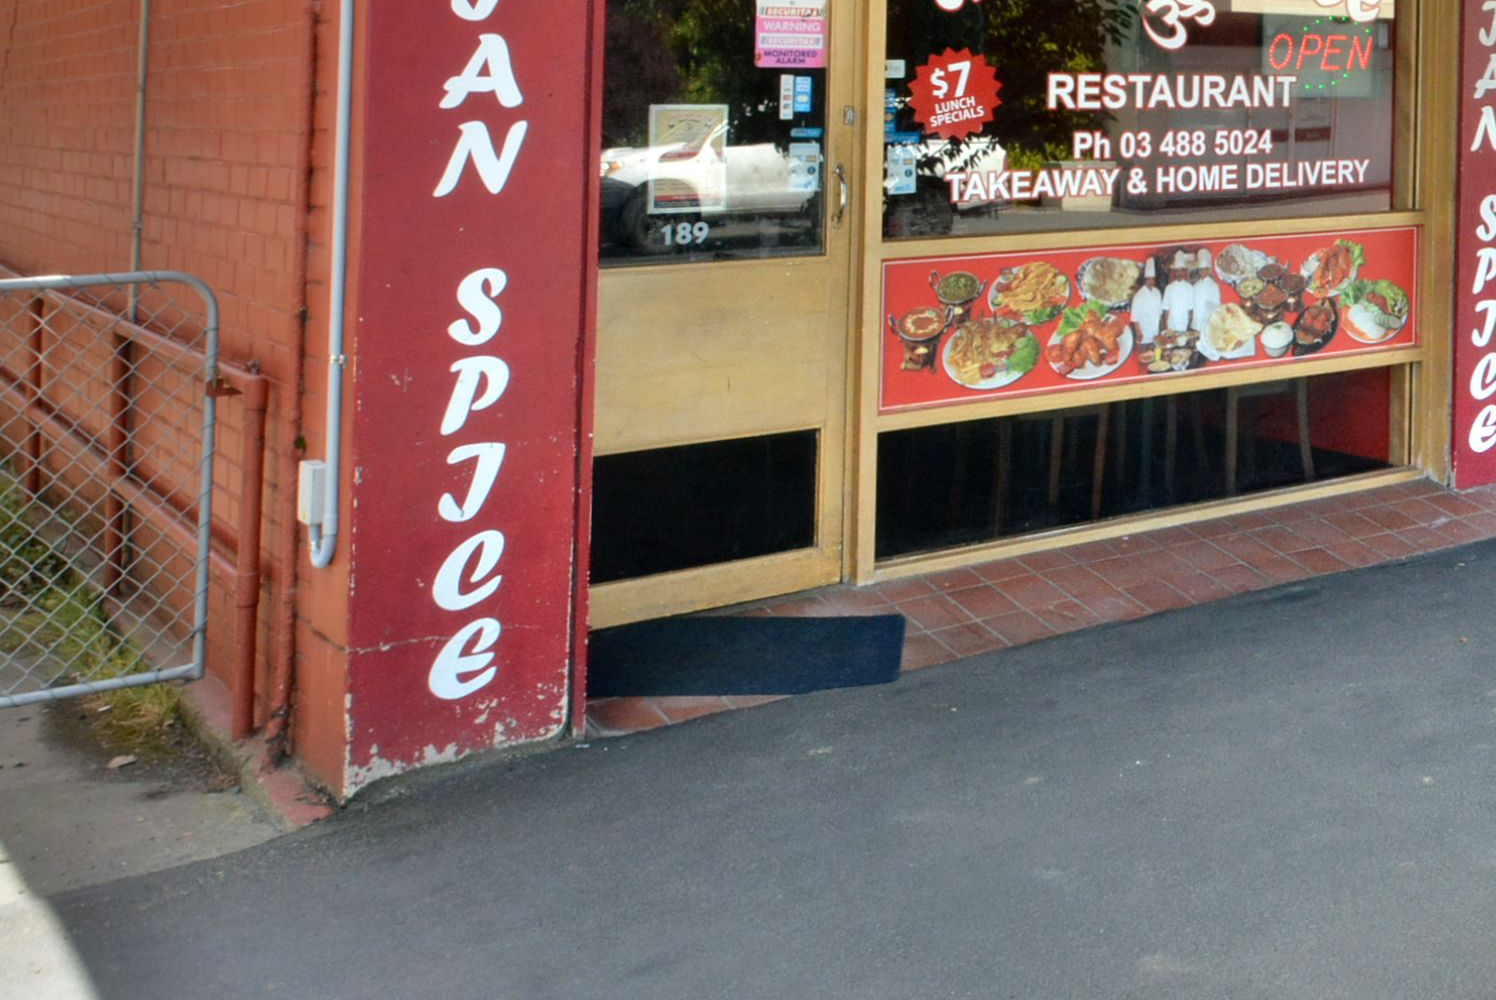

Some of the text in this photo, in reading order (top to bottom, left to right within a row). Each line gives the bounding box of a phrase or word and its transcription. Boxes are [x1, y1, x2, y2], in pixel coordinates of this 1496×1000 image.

[763, 22, 821, 32] WARNING
[764, 50, 818, 58] MONITORED
[775, 57, 806, 65] ALARM
[1268, 31, 1373, 71] OPEN
[930, 60, 971, 99] $7
[1047, 73, 1297, 110] RESTAURANT
[929, 105, 986, 128] SPECIALS
[934, 95, 976, 115] LUNCH
[1073, 129, 1273, 160] Ph 03 488 5024
[944, 168, 1120, 202] TAKEAWAY
[1126, 168, 1148, 195] &
[1155, 164, 1239, 194] HOME
[1247, 158, 1370, 189] DELIVERY
[660, 221, 709, 246] 189
